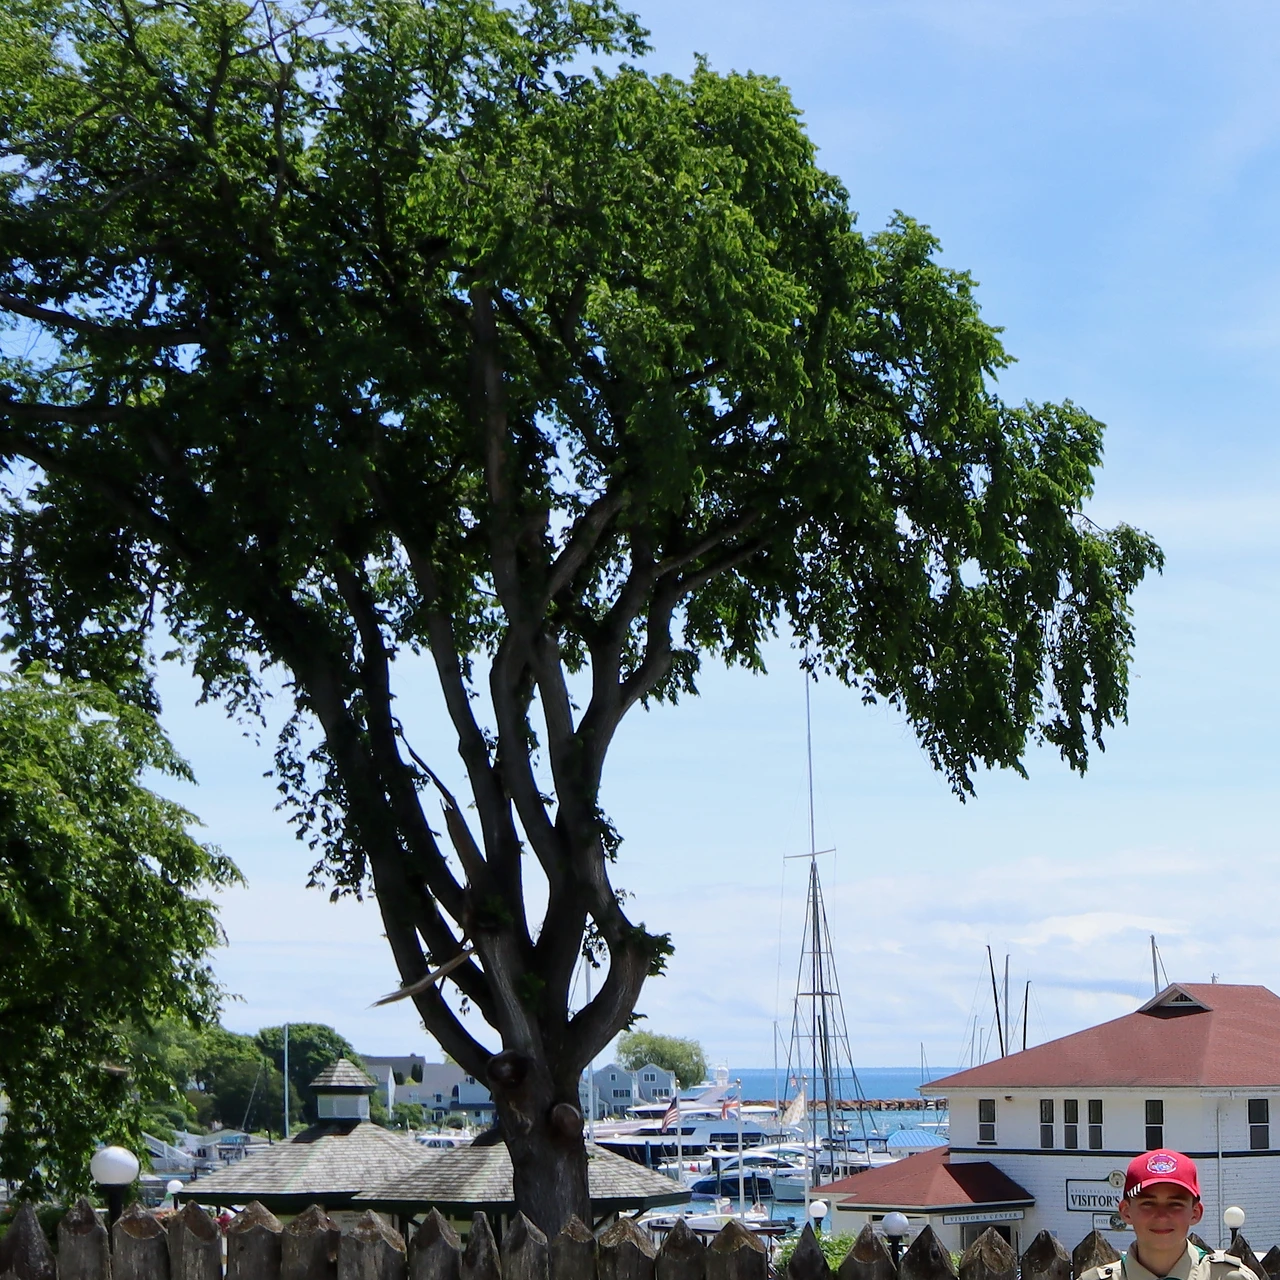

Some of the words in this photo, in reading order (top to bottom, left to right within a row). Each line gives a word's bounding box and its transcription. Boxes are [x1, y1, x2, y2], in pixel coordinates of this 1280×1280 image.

[1070, 1193, 1120, 1208] VISITOR'S
[949, 1214, 987, 1222] VISITOR'S
[989, 1211, 1019, 1219] CENTER
